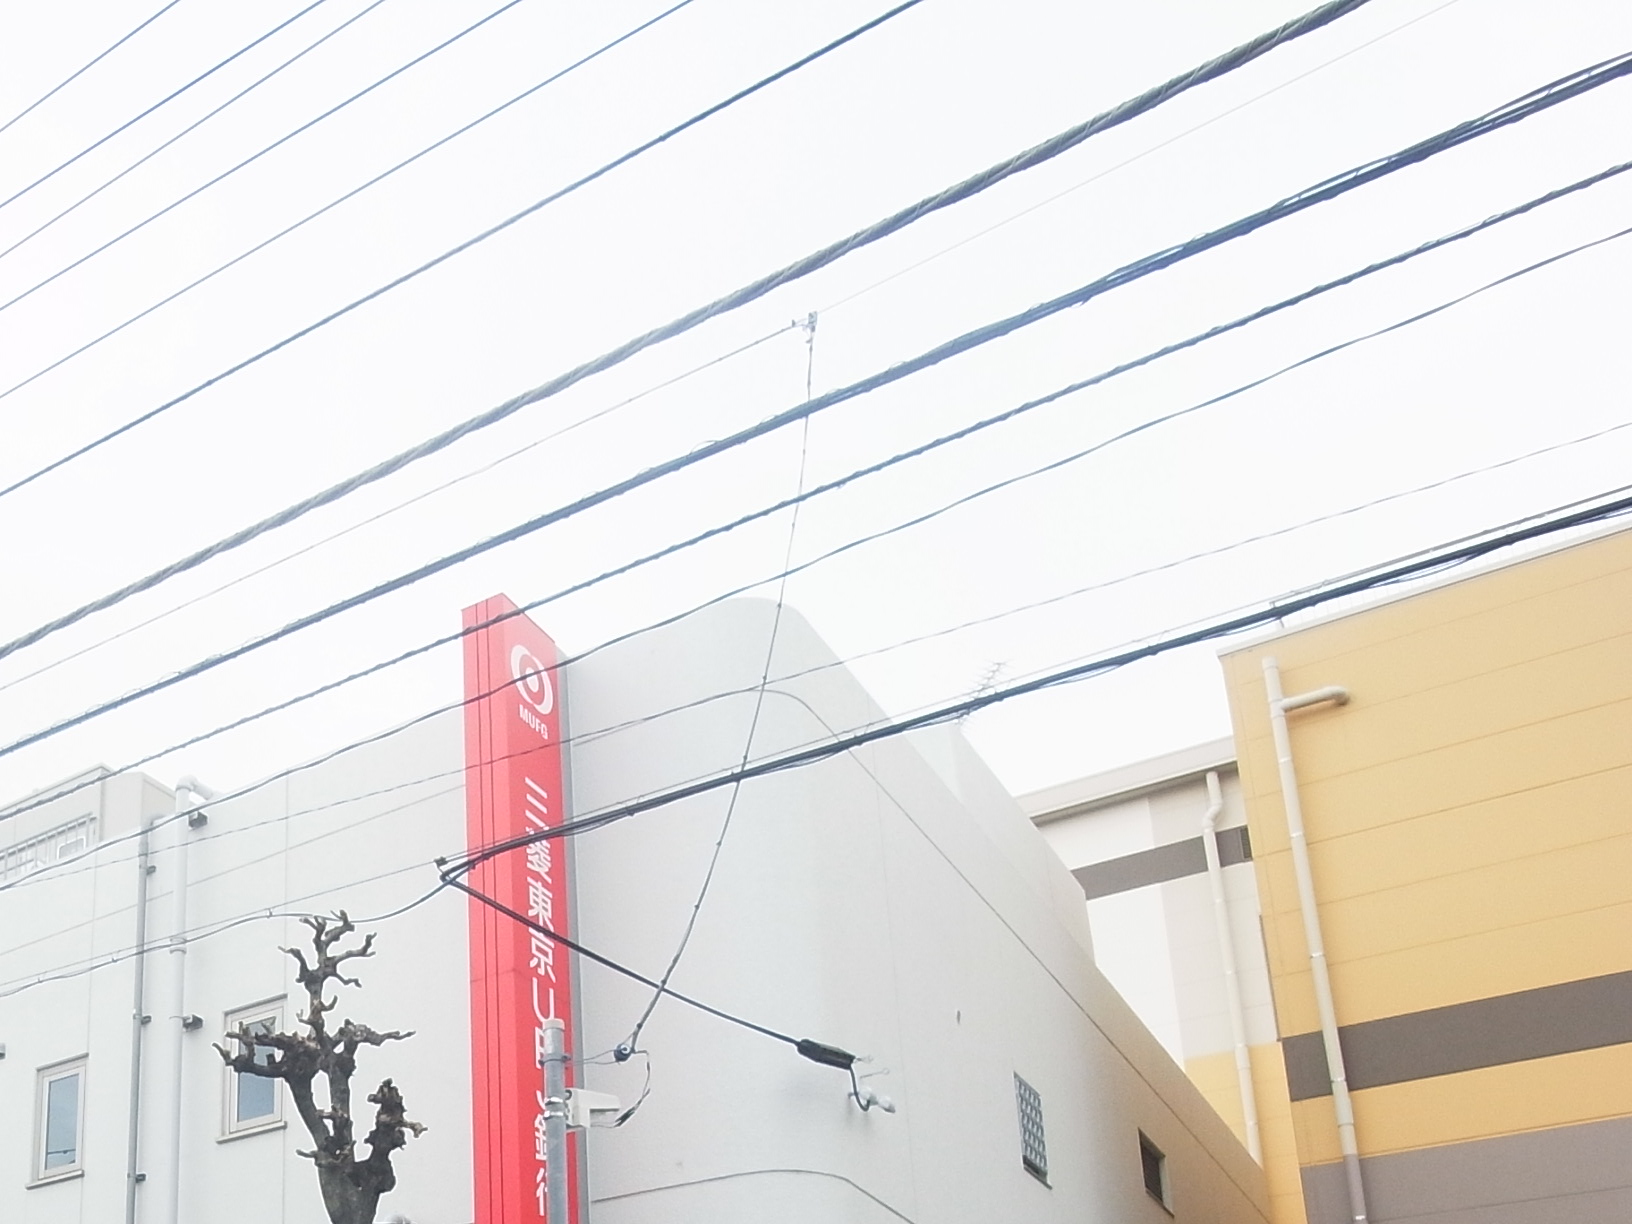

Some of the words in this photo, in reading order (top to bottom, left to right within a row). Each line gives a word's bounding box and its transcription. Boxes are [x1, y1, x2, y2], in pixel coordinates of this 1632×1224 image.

[519, 703, 548, 740] MUFG
[524, 776, 557, 1217] 三菱東京U
